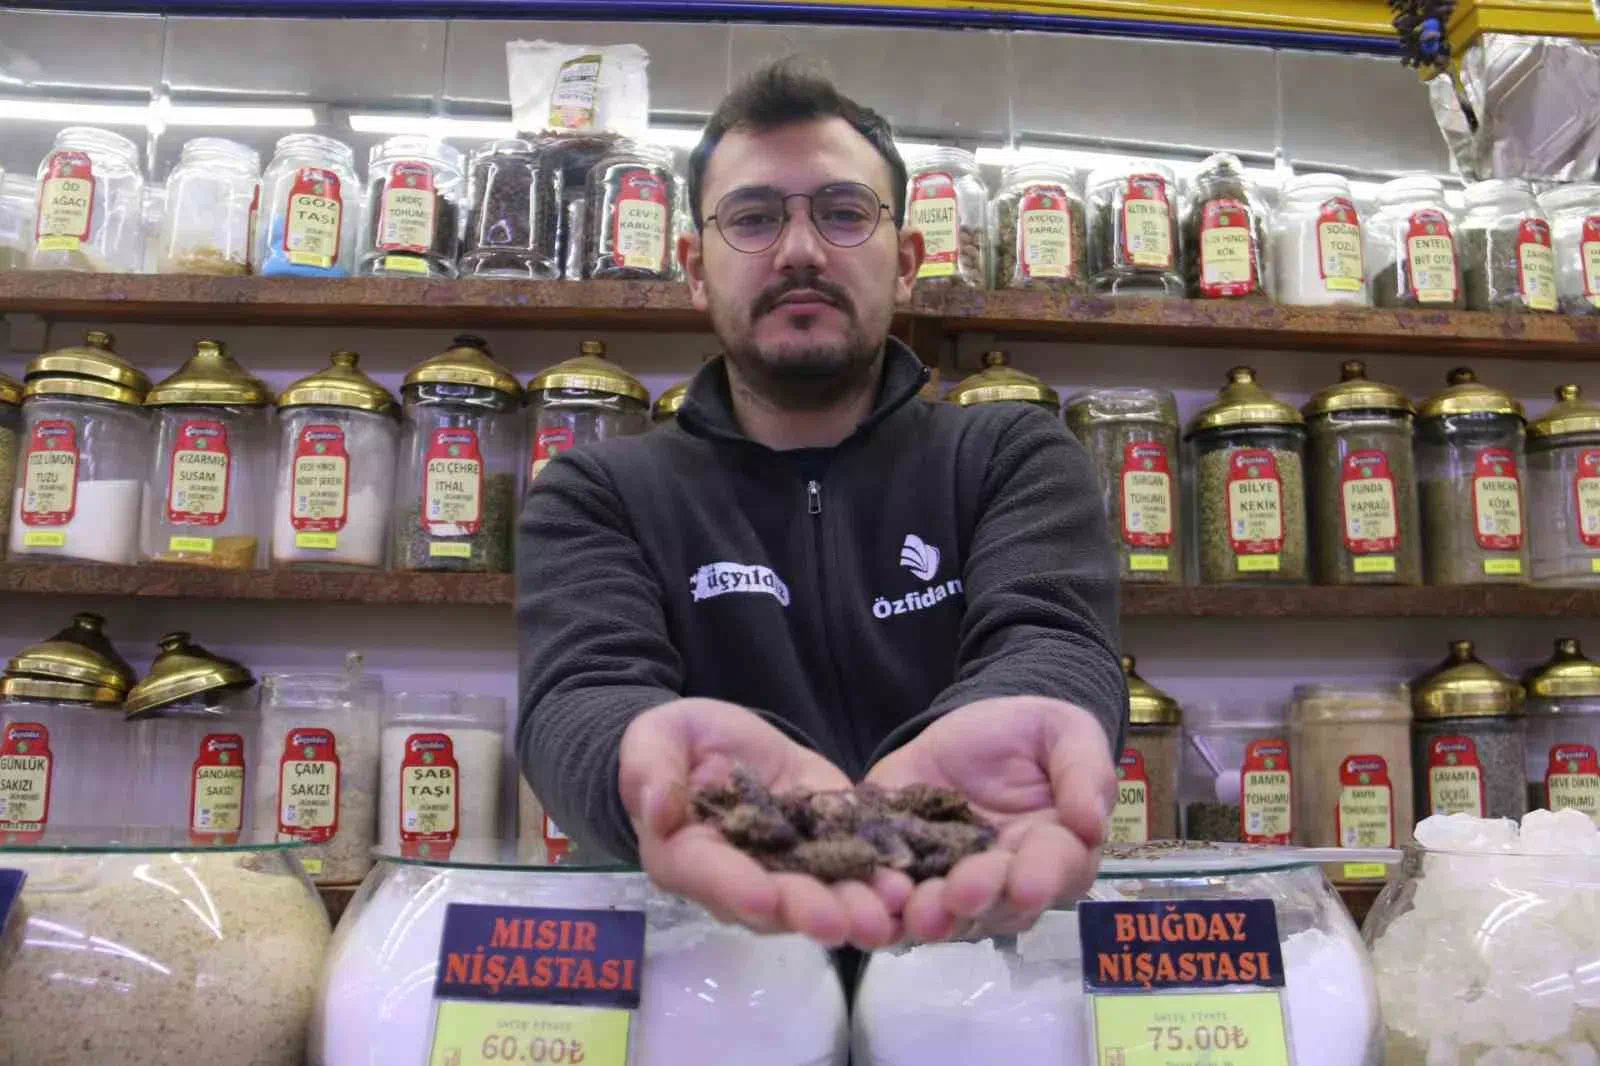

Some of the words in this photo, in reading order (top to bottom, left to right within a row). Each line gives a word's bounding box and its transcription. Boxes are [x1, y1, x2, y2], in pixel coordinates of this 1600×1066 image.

[179, 471, 216, 481] SUSAM
[1240, 500, 1278, 513] KEKİK
[872, 579, 964, 619] Özfidan
[294, 762, 325, 777] ÇAM
[413, 768, 451, 781] ŞAB
[290, 783, 330, 796] SAKIZI
[408, 785, 451, 798] TAŞI
[1113, 903, 1248, 943] BUĞDAY
[488, 916, 598, 953] MISIR
[443, 944, 636, 995] NİŞASTASI
[1097, 944, 1272, 990] NİŞASTASI
